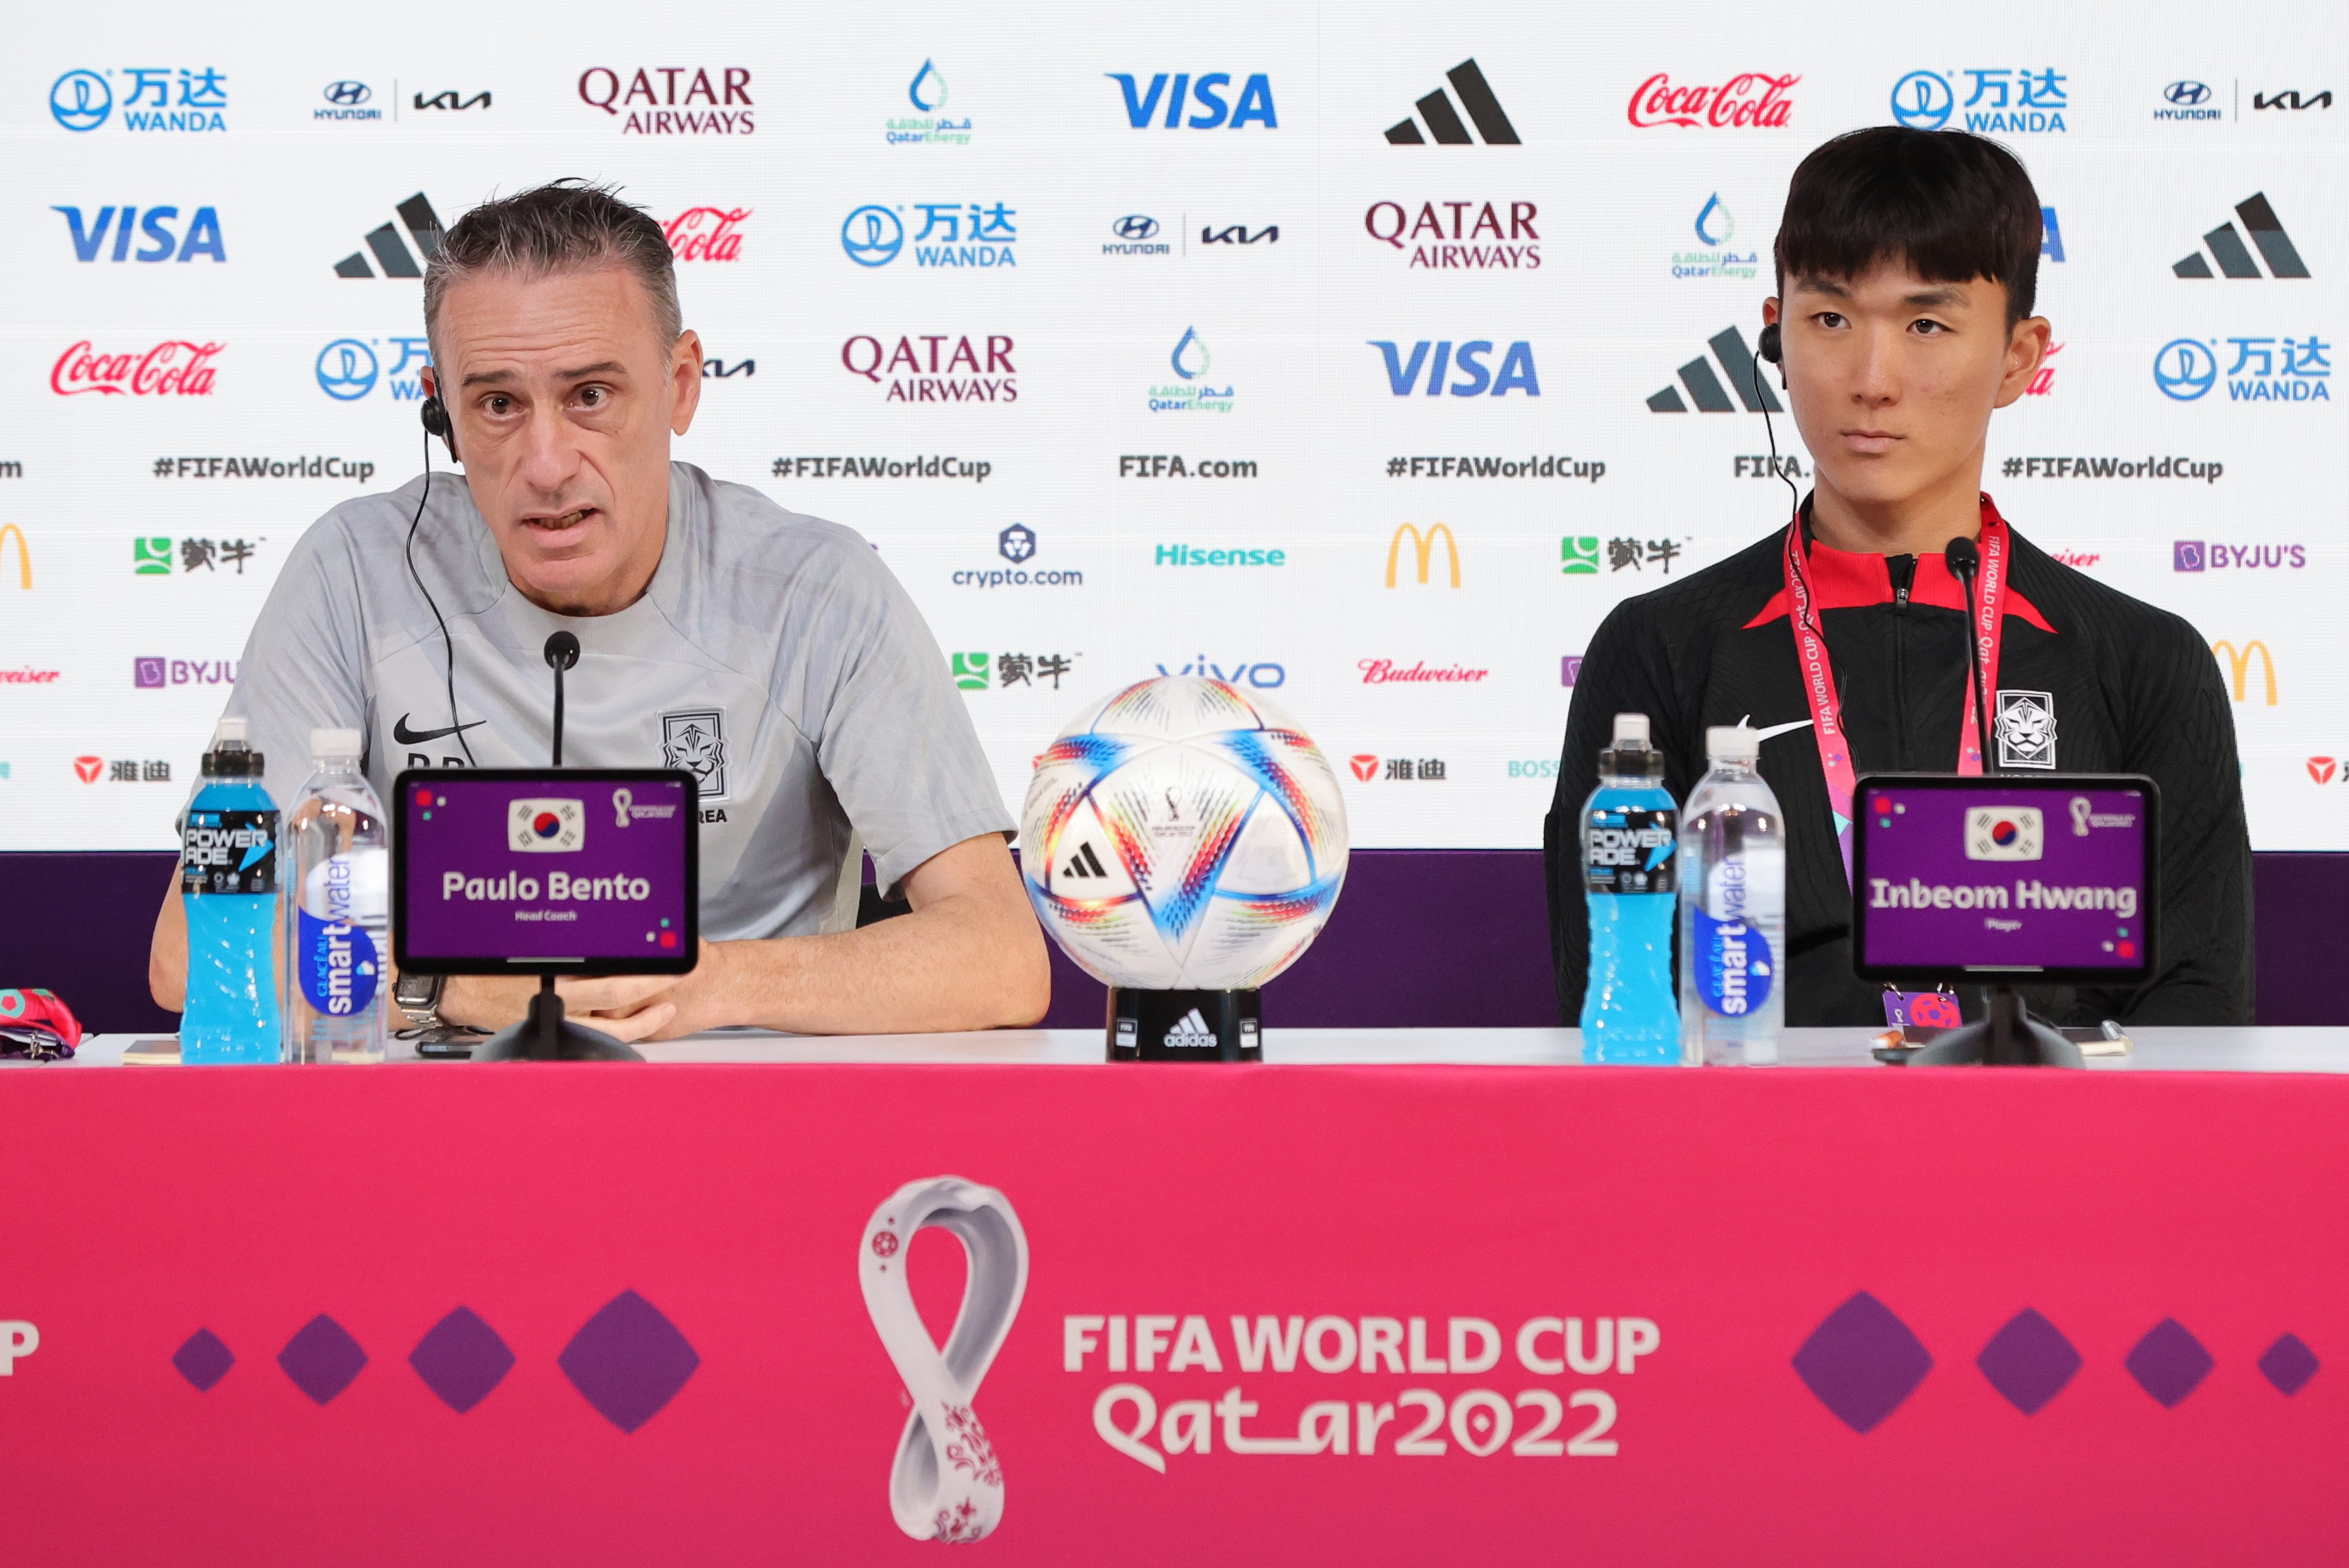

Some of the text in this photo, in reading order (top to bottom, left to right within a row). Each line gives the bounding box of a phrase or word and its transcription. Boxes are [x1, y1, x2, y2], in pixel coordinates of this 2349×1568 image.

[123, 67, 227, 107] 万达
[578, 67, 753, 115] QATAR
[1964, 67, 2066, 107] 万达
[1105, 72, 1278, 129] VISA
[1628, 73, 1802, 128] Coca-Cola
[124, 112, 226, 132] WANDA
[314, 109, 381, 120] HYUNDAI
[623, 112, 755, 134] AIRWAYS
[1964, 112, 2066, 132] WANDA
[2154, 109, 2222, 120] HYUNDAI
[887, 132, 971, 143] QatarEnergy
[50, 205, 226, 262] VISA
[914, 202, 1016, 242] 万达
[1365, 201, 1539, 249] QATAR
[915, 246, 1016, 267] WANDA
[1103, 244, 1169, 255] HYUNDAI
[1410, 246, 1541, 269] AIRWAYS
[1672, 265, 1757, 278] QatarEnergy
[50, 340, 226, 396] Coca-Cola
[842, 335, 1016, 383] QATAR
[2227, 336, 2331, 376] 万达
[1367, 340, 1540, 398] VISA
[887, 380, 1017, 402] AIRWAYS
[2228, 380, 2330, 401] WANDA
[1149, 399, 1233, 412] QatarEnergy
[153, 455, 374, 483] #FIFAWorldCup
[772, 455, 991, 483] #FIFAWorldCup
[1120, 455, 1257, 478] FIFA.com
[1386, 455, 1605, 483] #FIFAWorldCup
[2002, 455, 2223, 484] #FIFAWorldCup
[181, 537, 255, 574] 蒙牛
[1155, 544, 1285, 567] Hisense
[1607, 537, 1681, 574] 蒙牛
[1988, 536, 2000, 557] FIFA
[2211, 544, 2306, 568] BYJU'S
[953, 568, 1083, 588] crypto.com
[1985, 558, 1998, 606] WORLD
[1981, 607, 1993, 630] CUP
[1804, 636, 1819, 660] CUP
[998, 652, 1071, 690] 蒙牛
[1358, 659, 1488, 684] Budweiser
[1809, 661, 1829, 705] WORLD
[1819, 706, 1835, 736] FIFA
[1385, 758, 1446, 780] 雅迪
[186, 829, 268, 848] POWER
[1590, 828, 1672, 847] POWER
[443, 871, 650, 900] Paulo Bento
[1869, 878, 2137, 918] Inbeom Hwang
[515, 910, 577, 921] Head Coach
[1163, 1032, 1218, 1048] adidas
[1064, 1315, 1660, 1375] FIFA WORLD CUP
